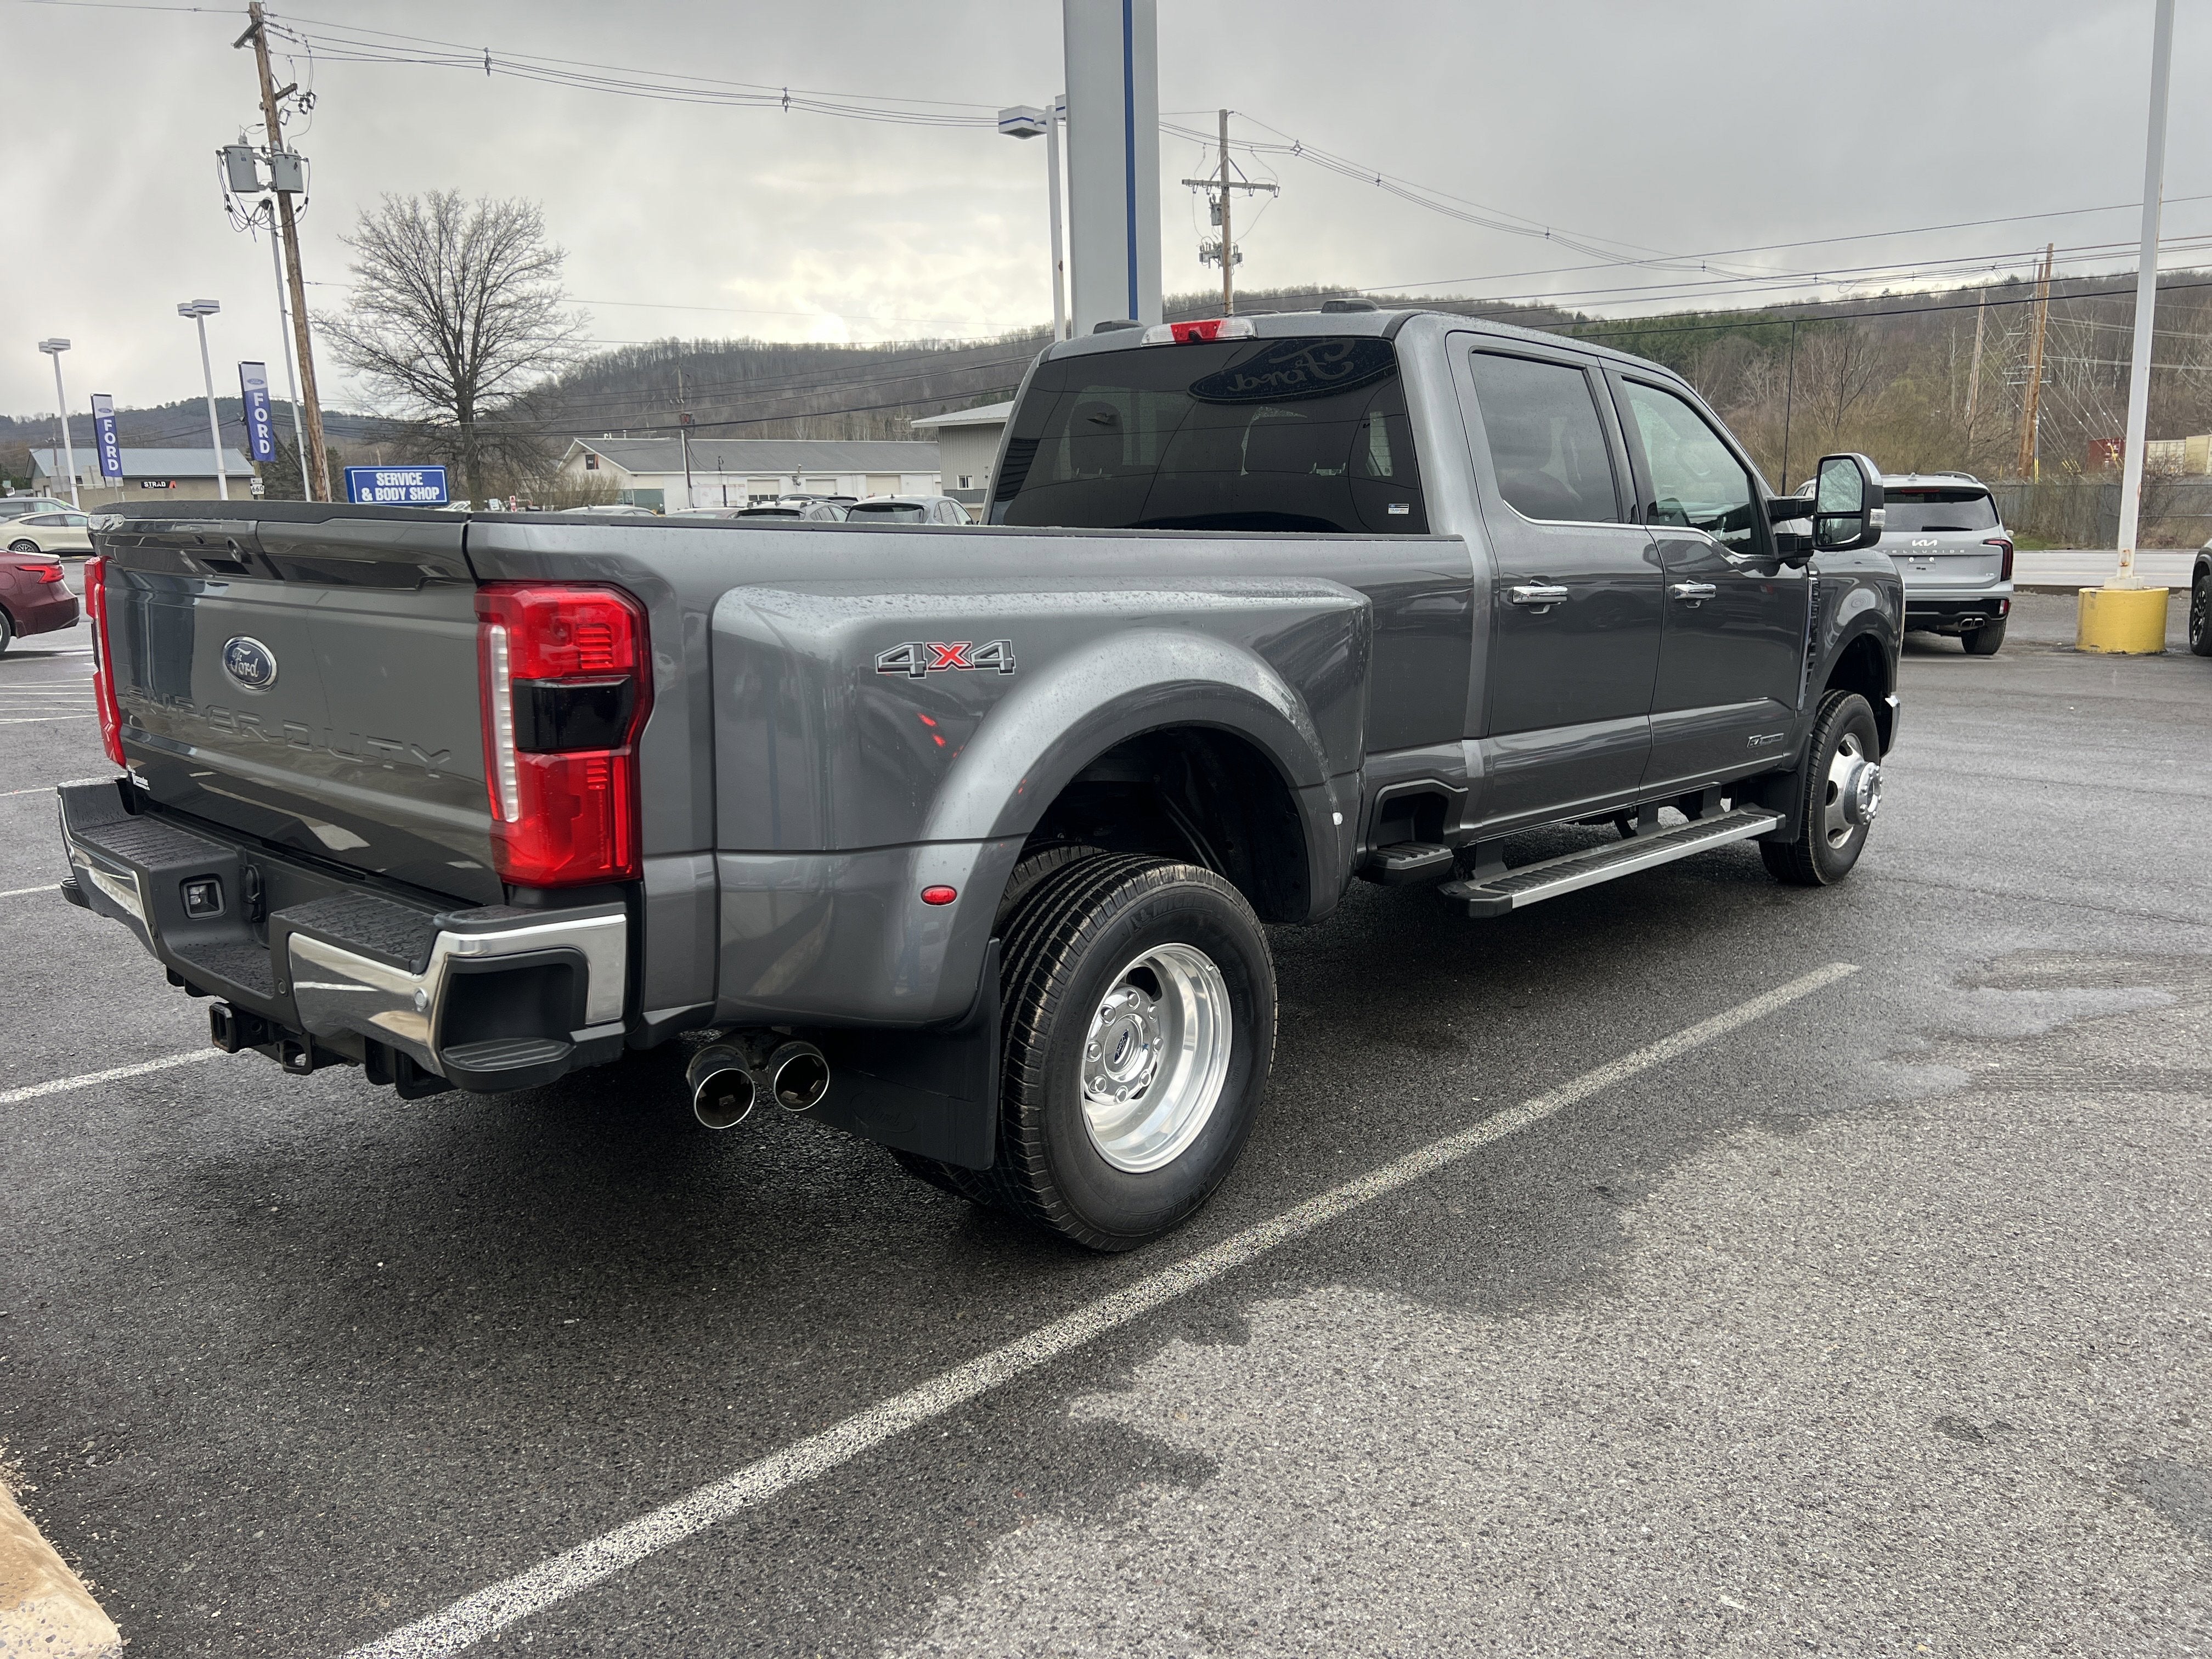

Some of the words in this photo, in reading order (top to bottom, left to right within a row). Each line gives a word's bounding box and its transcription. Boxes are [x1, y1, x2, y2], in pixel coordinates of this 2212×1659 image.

[253, 392, 270, 454] FORD
[103, 419, 119, 471] FORD
[361, 487, 373, 501] &
[375, 487, 406, 501] BODY
[409, 486, 439, 500] SHOP
[376, 472, 424, 487] SERVICE
[230, 647, 259, 678] Ford
[283, 719, 452, 778] DUTY
